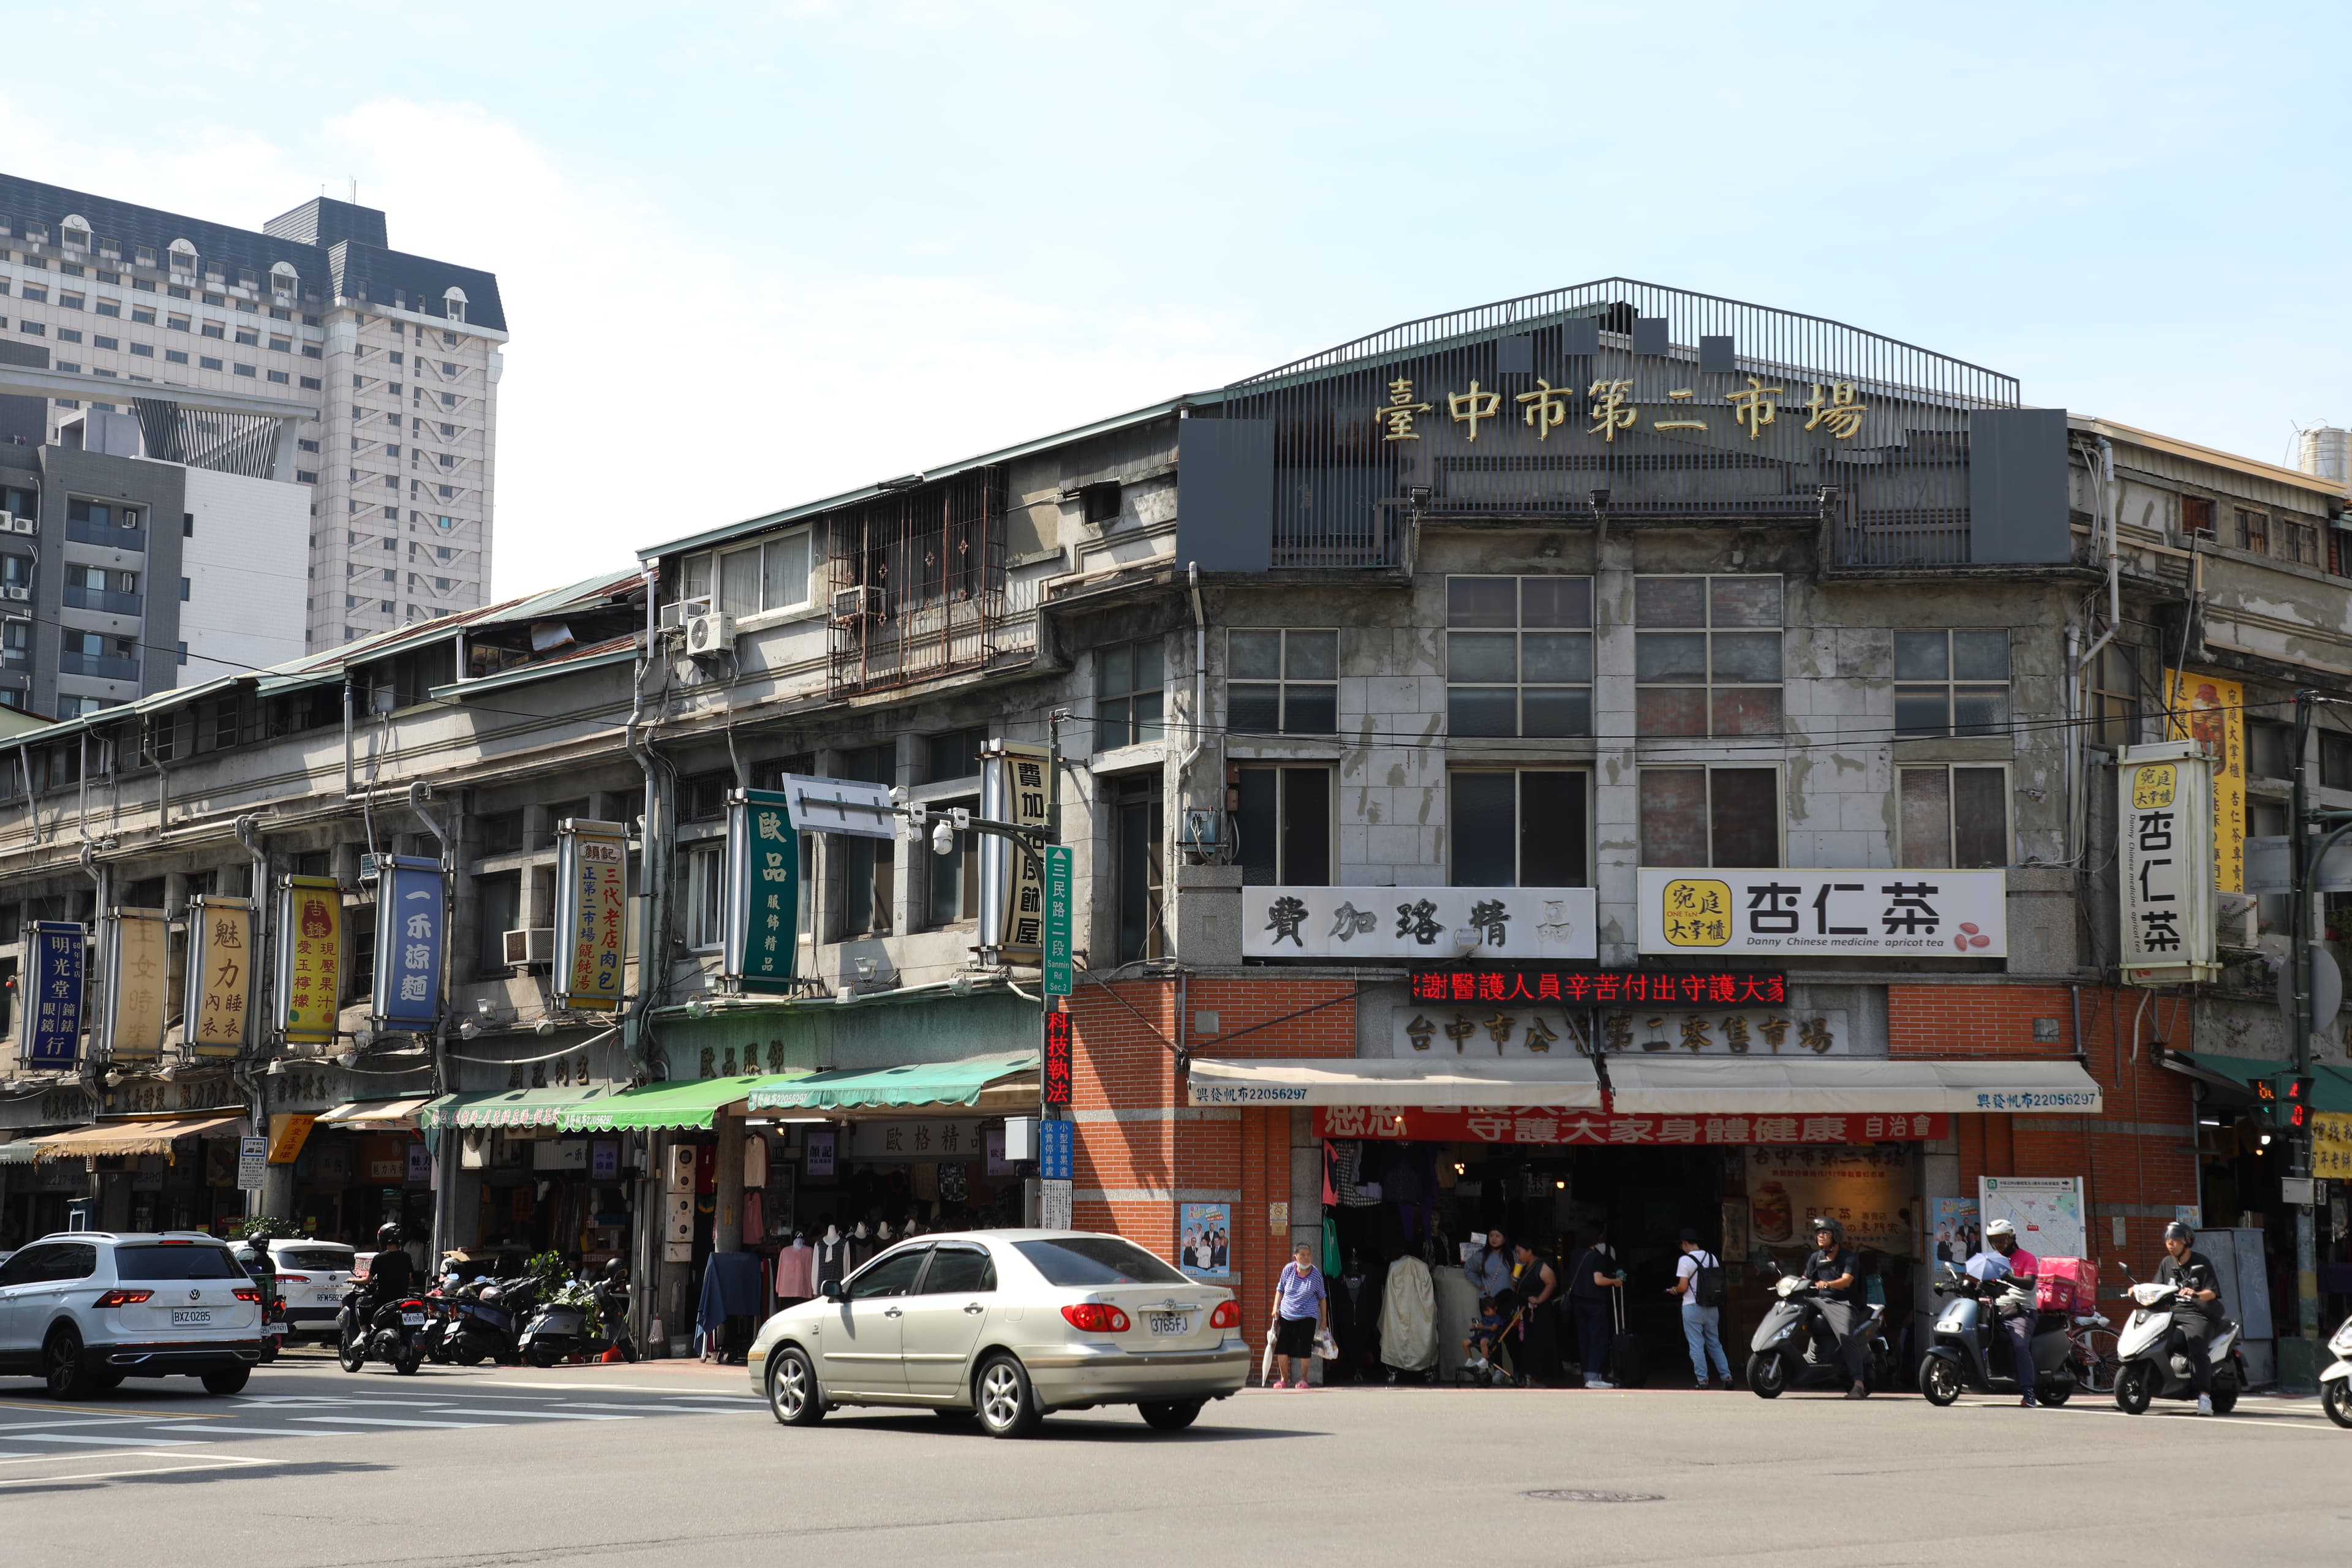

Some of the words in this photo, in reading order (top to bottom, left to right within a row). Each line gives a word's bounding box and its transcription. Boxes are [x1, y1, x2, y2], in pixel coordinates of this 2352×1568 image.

[1375, 375, 1869, 443] 臺中市第二市場
[2228, 688, 2241, 778] 宛庭大掌櫃
[2141, 768, 2172, 788] 宛庭
[2135, 789, 2173, 805] 大掌櫃
[2127, 814, 2136, 839] Danny
[584, 844, 617, 860] 顏記
[758, 810, 788, 883] 歐品
[2138, 811, 2181, 952] 杏仁茶
[1052, 863, 1066, 957] 三民路二段
[1672, 884, 1723, 914] 宛庭
[1746, 881, 1940, 935] 杏仁茶
[575, 865, 598, 990] 正第二市場餛飩湯
[597, 867, 623, 990] 三代老店肉包
[761, 894, 782, 973] 服飾精品
[1668, 919, 1726, 941] 大掌櫃
[1747, 937, 1781, 948] Danny
[1787, 937, 1830, 946] Chinese
[1831, 937, 1880, 947] medicine
[1885, 937, 1924, 949] apricot
[1926, 938, 1945, 948] tea
[51, 936, 70, 999] 明光堂
[73, 941, 81, 978] 60年老店
[213, 918, 242, 989] 魅力
[1047, 960, 1069, 969] Sanmin
[292, 940, 312, 1009] 愛玉檸檬
[317, 942, 337, 1009] 現壓果汁
[1049, 982, 1067, 992] Sec.2
[1054, 971, 1064, 980] Rd.
[1413, 971, 1784, 1003] 謝醫護人員辛苦付出守護大家
[40, 1002, 56, 1033] 眼鏡
[61, 1003, 77, 1033] 鐘錶
[202, 992, 221, 1038] 內衣
[223, 993, 243, 1039] 睡衣
[45, 1036, 64, 1055] 行
[1047, 1012, 1069, 1103] 科技執法
[1196, 1087, 1308, 1102] 興發帆布22056297
[1976, 1092, 2097, 1109] 興發帆布22056297
[1467, 1116, 1848, 1144] 守護大家身體健康
[1864, 1114, 1932, 1137] 自治會
[1044, 1123, 1054, 1177] 收費停車處
[173, 1311, 211, 1323] BXZ-0285
